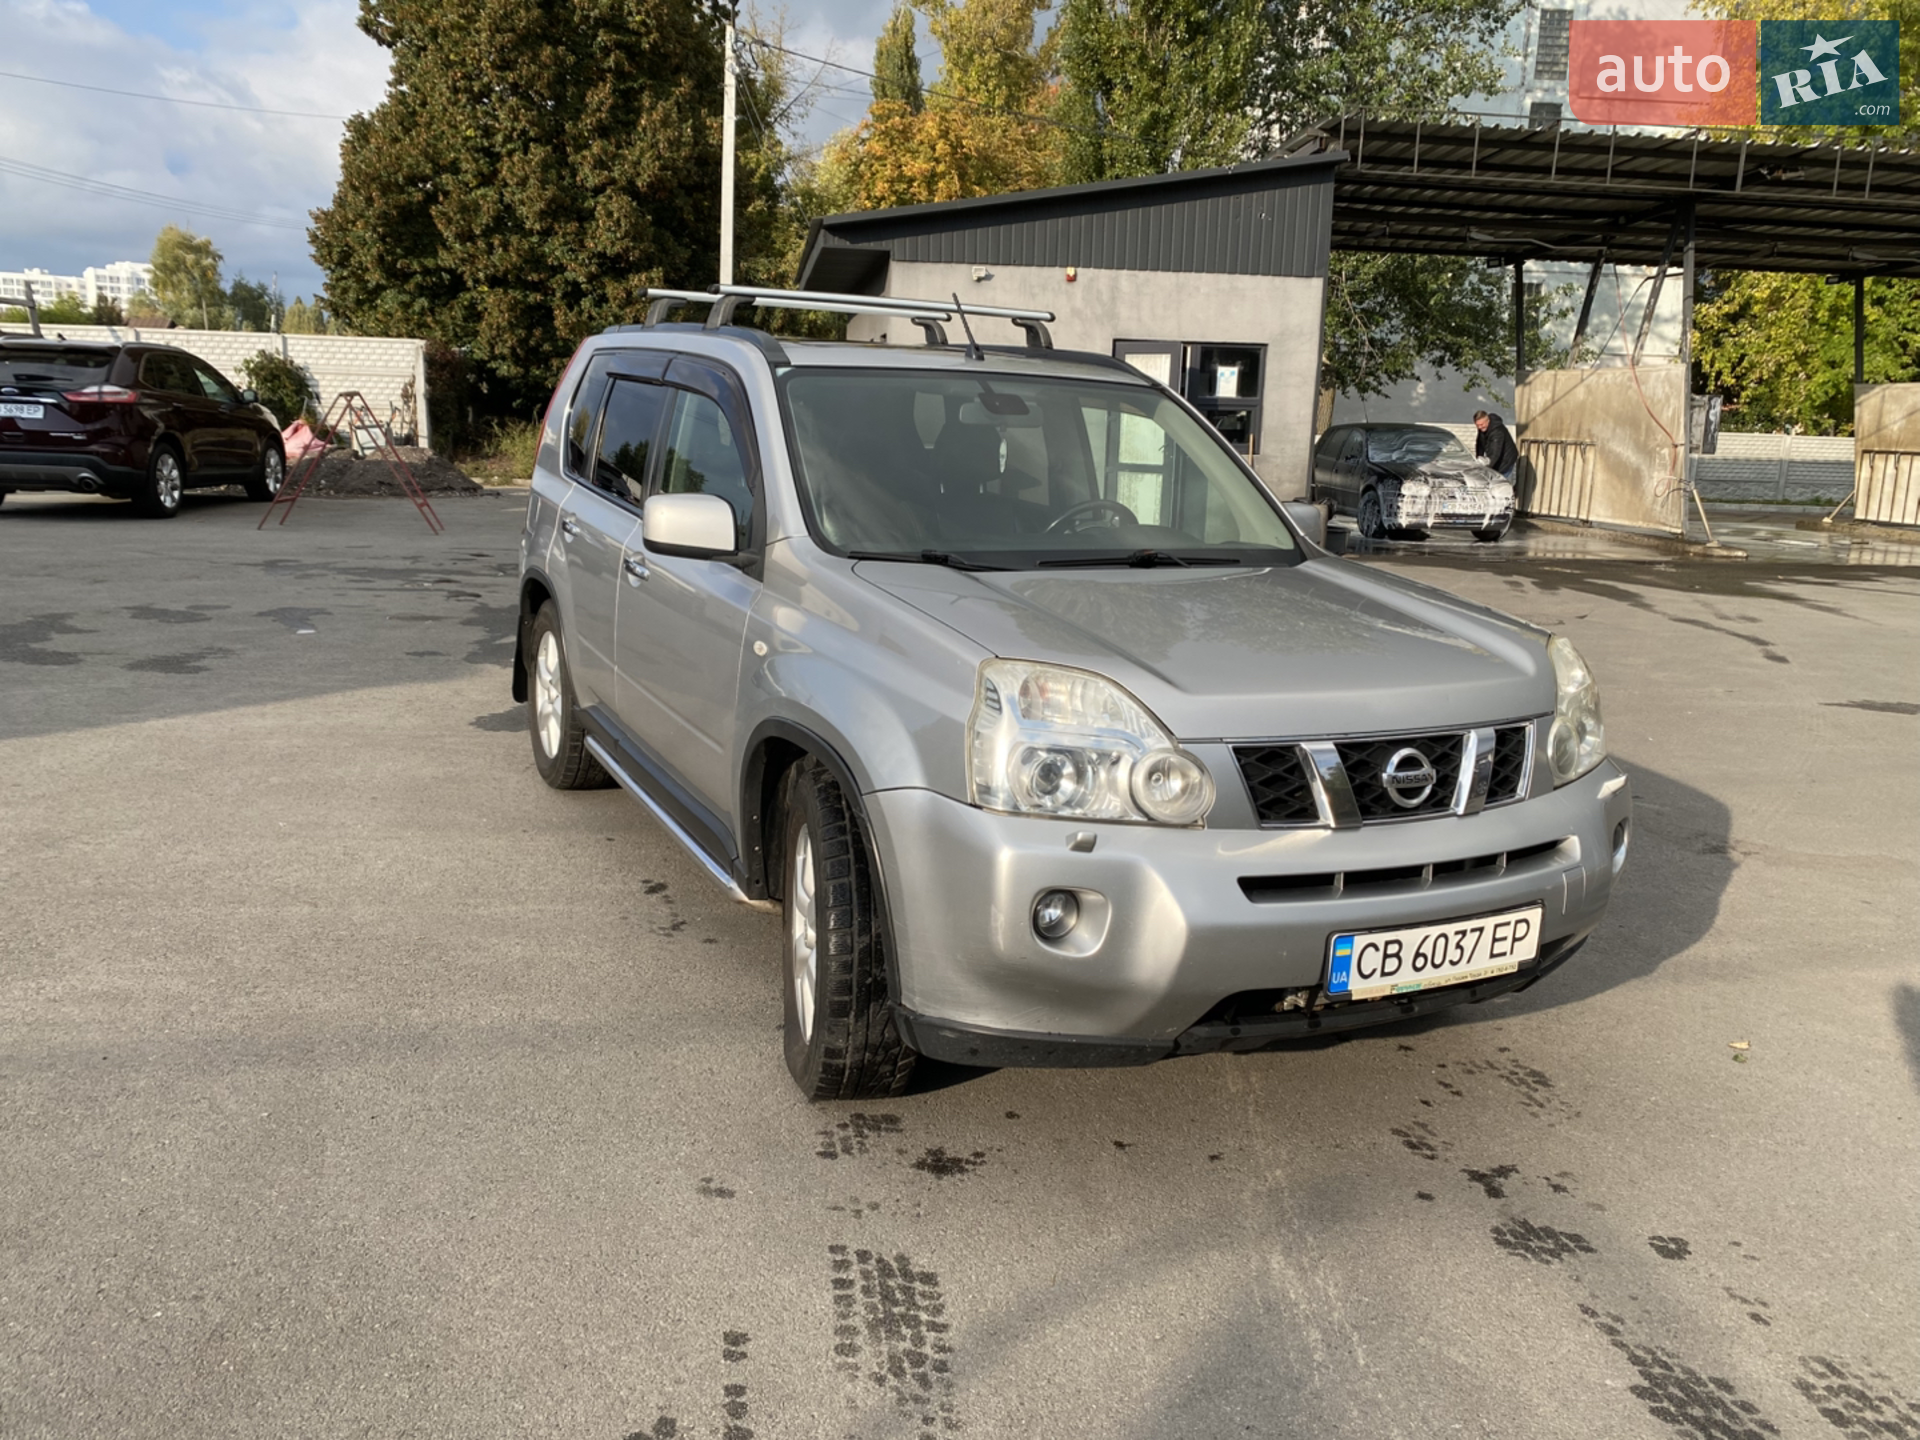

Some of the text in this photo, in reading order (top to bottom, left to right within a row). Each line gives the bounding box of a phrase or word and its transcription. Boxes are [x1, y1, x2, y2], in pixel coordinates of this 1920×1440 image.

[27, 404, 41, 415] EP
[1391, 772, 1434, 785] NISSAN
[1356, 939, 1404, 980] CB
[1411, 926, 1485, 973] 6037
[1489, 918, 1531, 960] EP
[1332, 971, 1348, 984] UA
